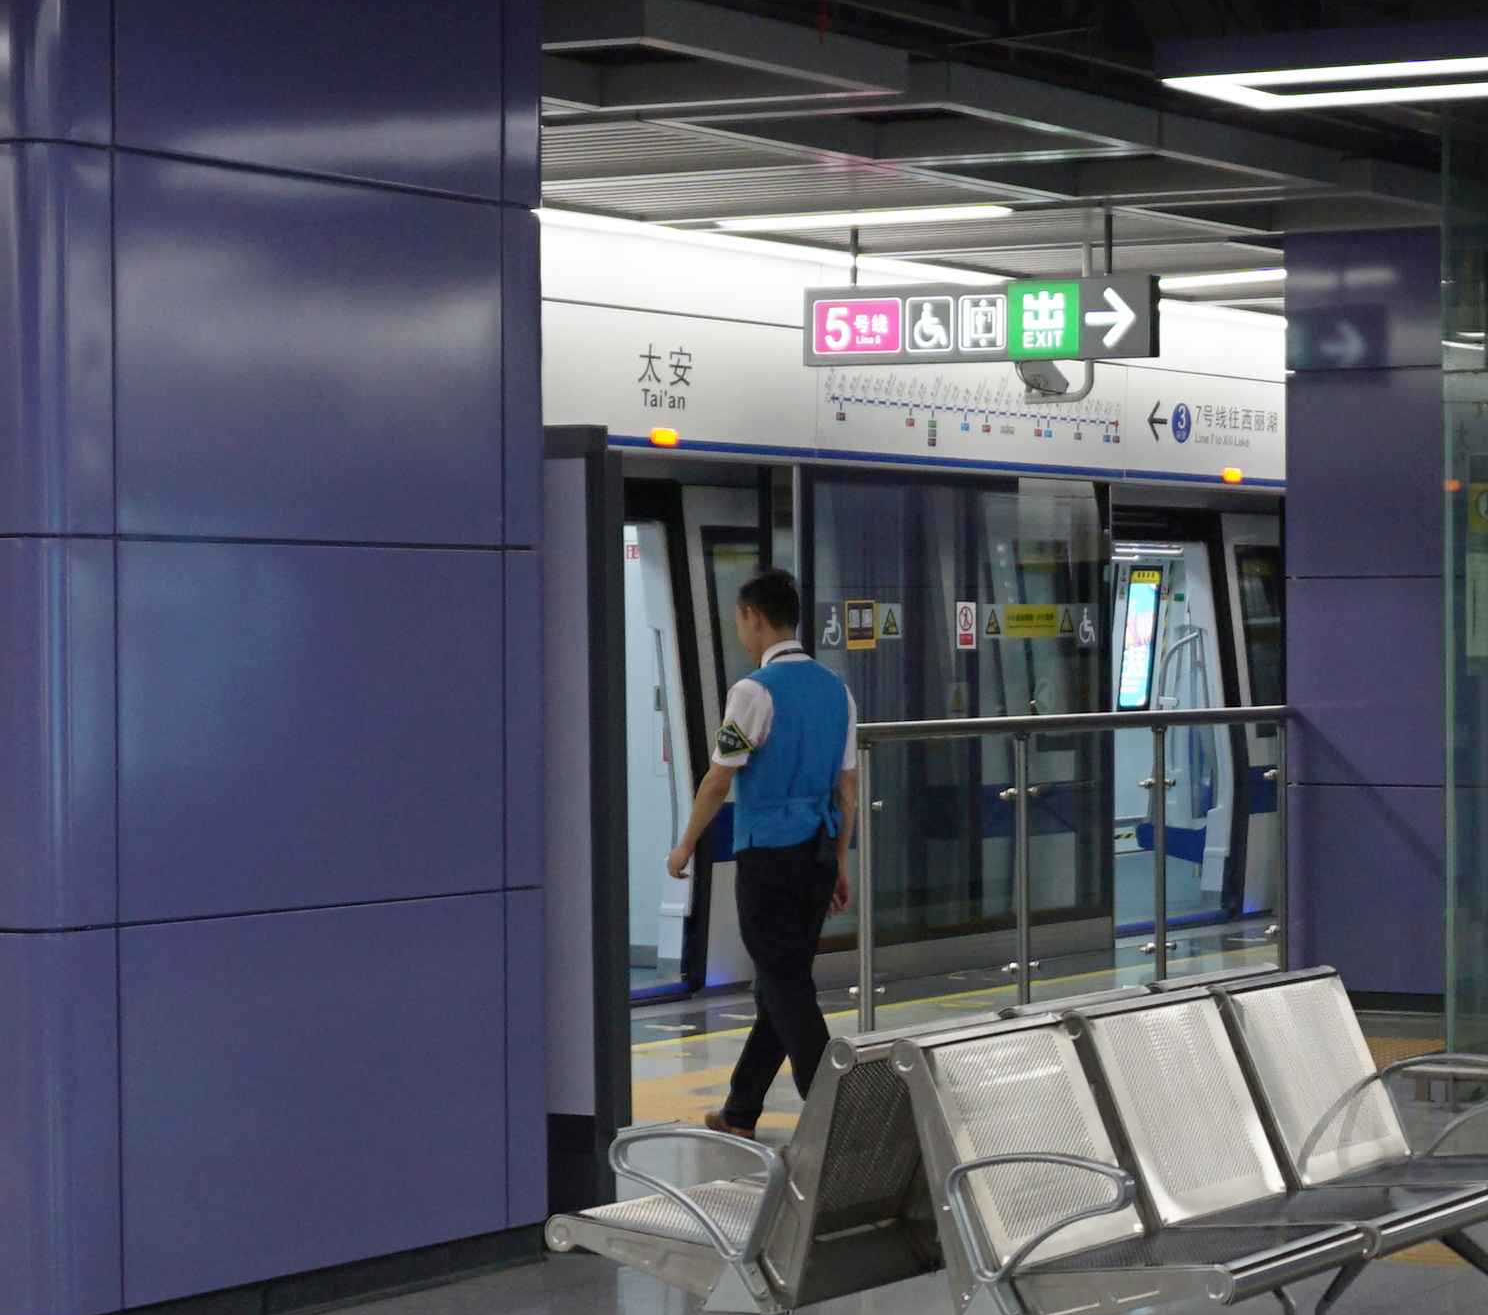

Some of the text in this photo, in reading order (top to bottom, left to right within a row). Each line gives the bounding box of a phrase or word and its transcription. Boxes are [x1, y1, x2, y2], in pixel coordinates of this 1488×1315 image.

[1023, 290, 1065, 329] 出
[1023, 330, 1064, 349] EXIT
[638, 343, 693, 386] 太安
[641, 388, 686, 410] Tai'an
[1178, 406, 1186, 429] 3
